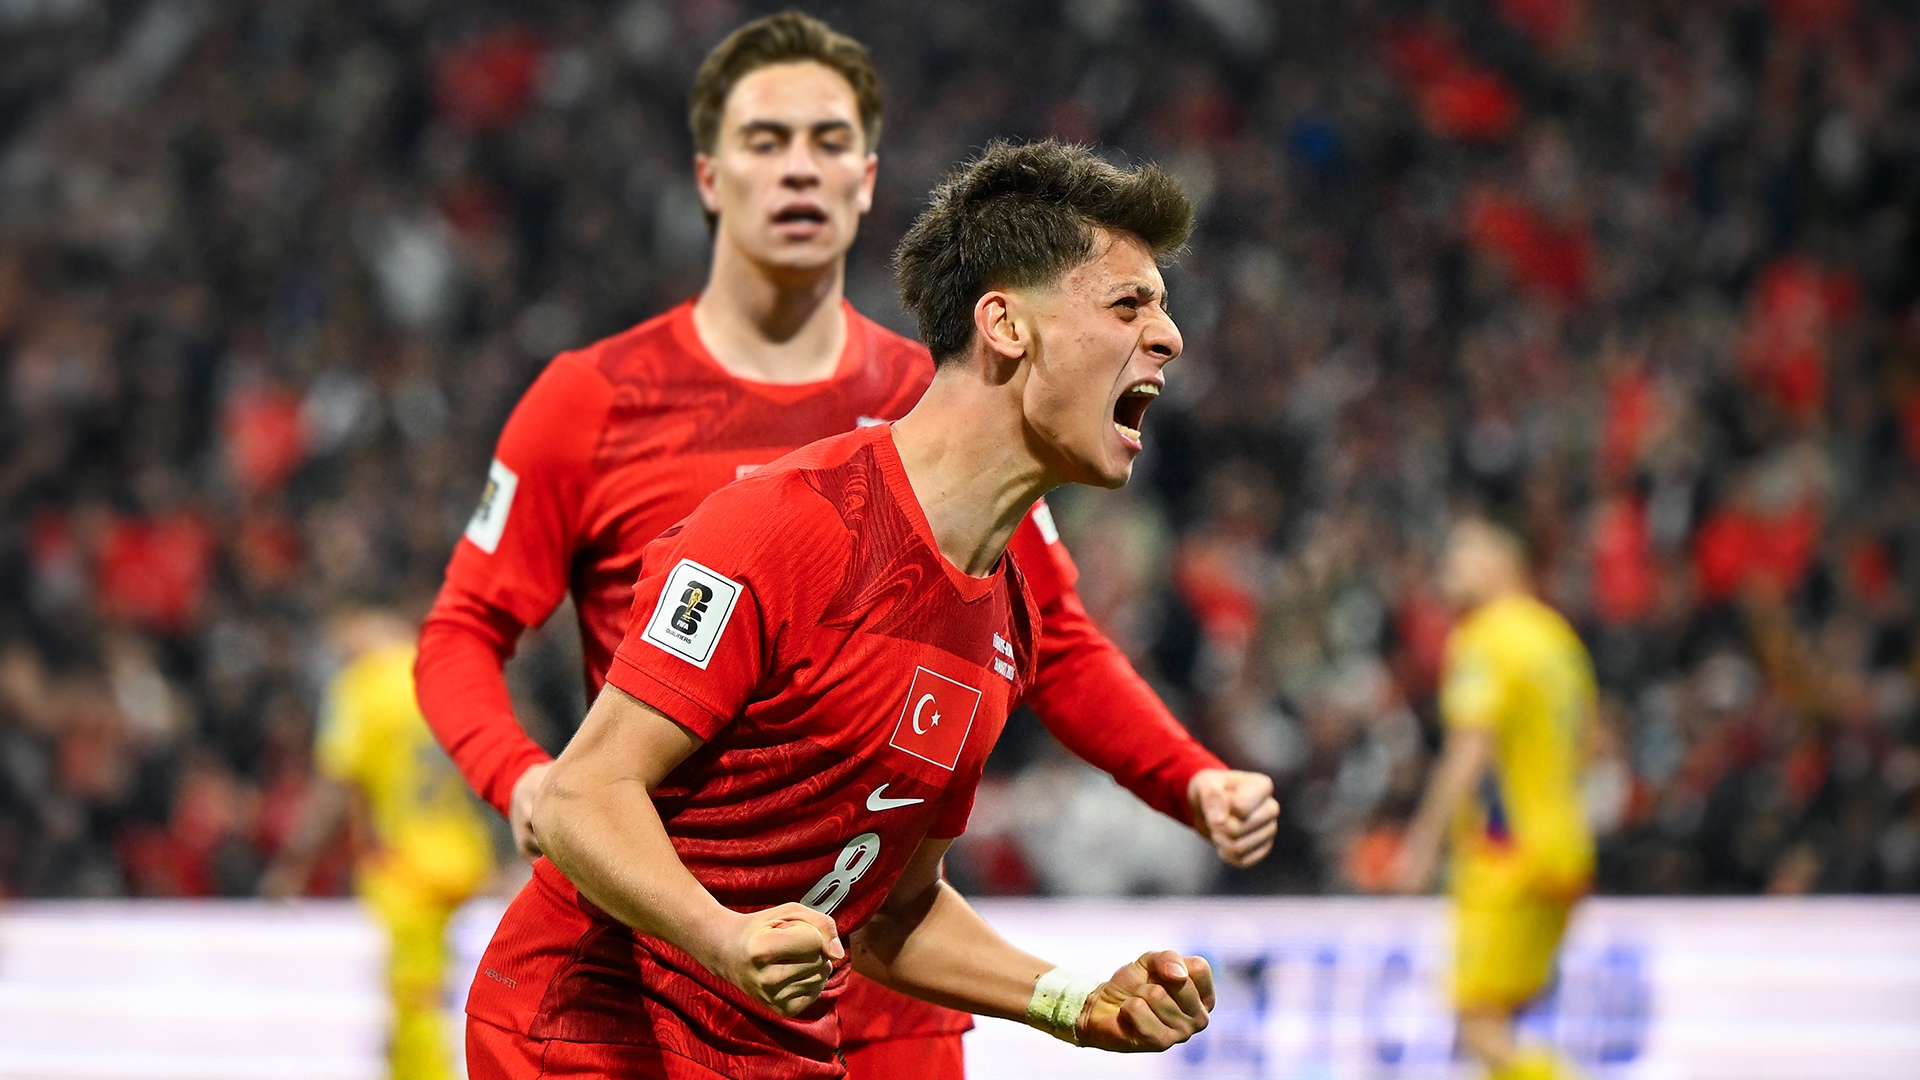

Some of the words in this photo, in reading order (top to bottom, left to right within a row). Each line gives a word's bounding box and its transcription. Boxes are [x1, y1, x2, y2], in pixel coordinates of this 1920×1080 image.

[676, 620, 690, 631] FIFA
[665, 628, 693, 645] QUALIFIERS
[799, 832, 881, 917] 8
